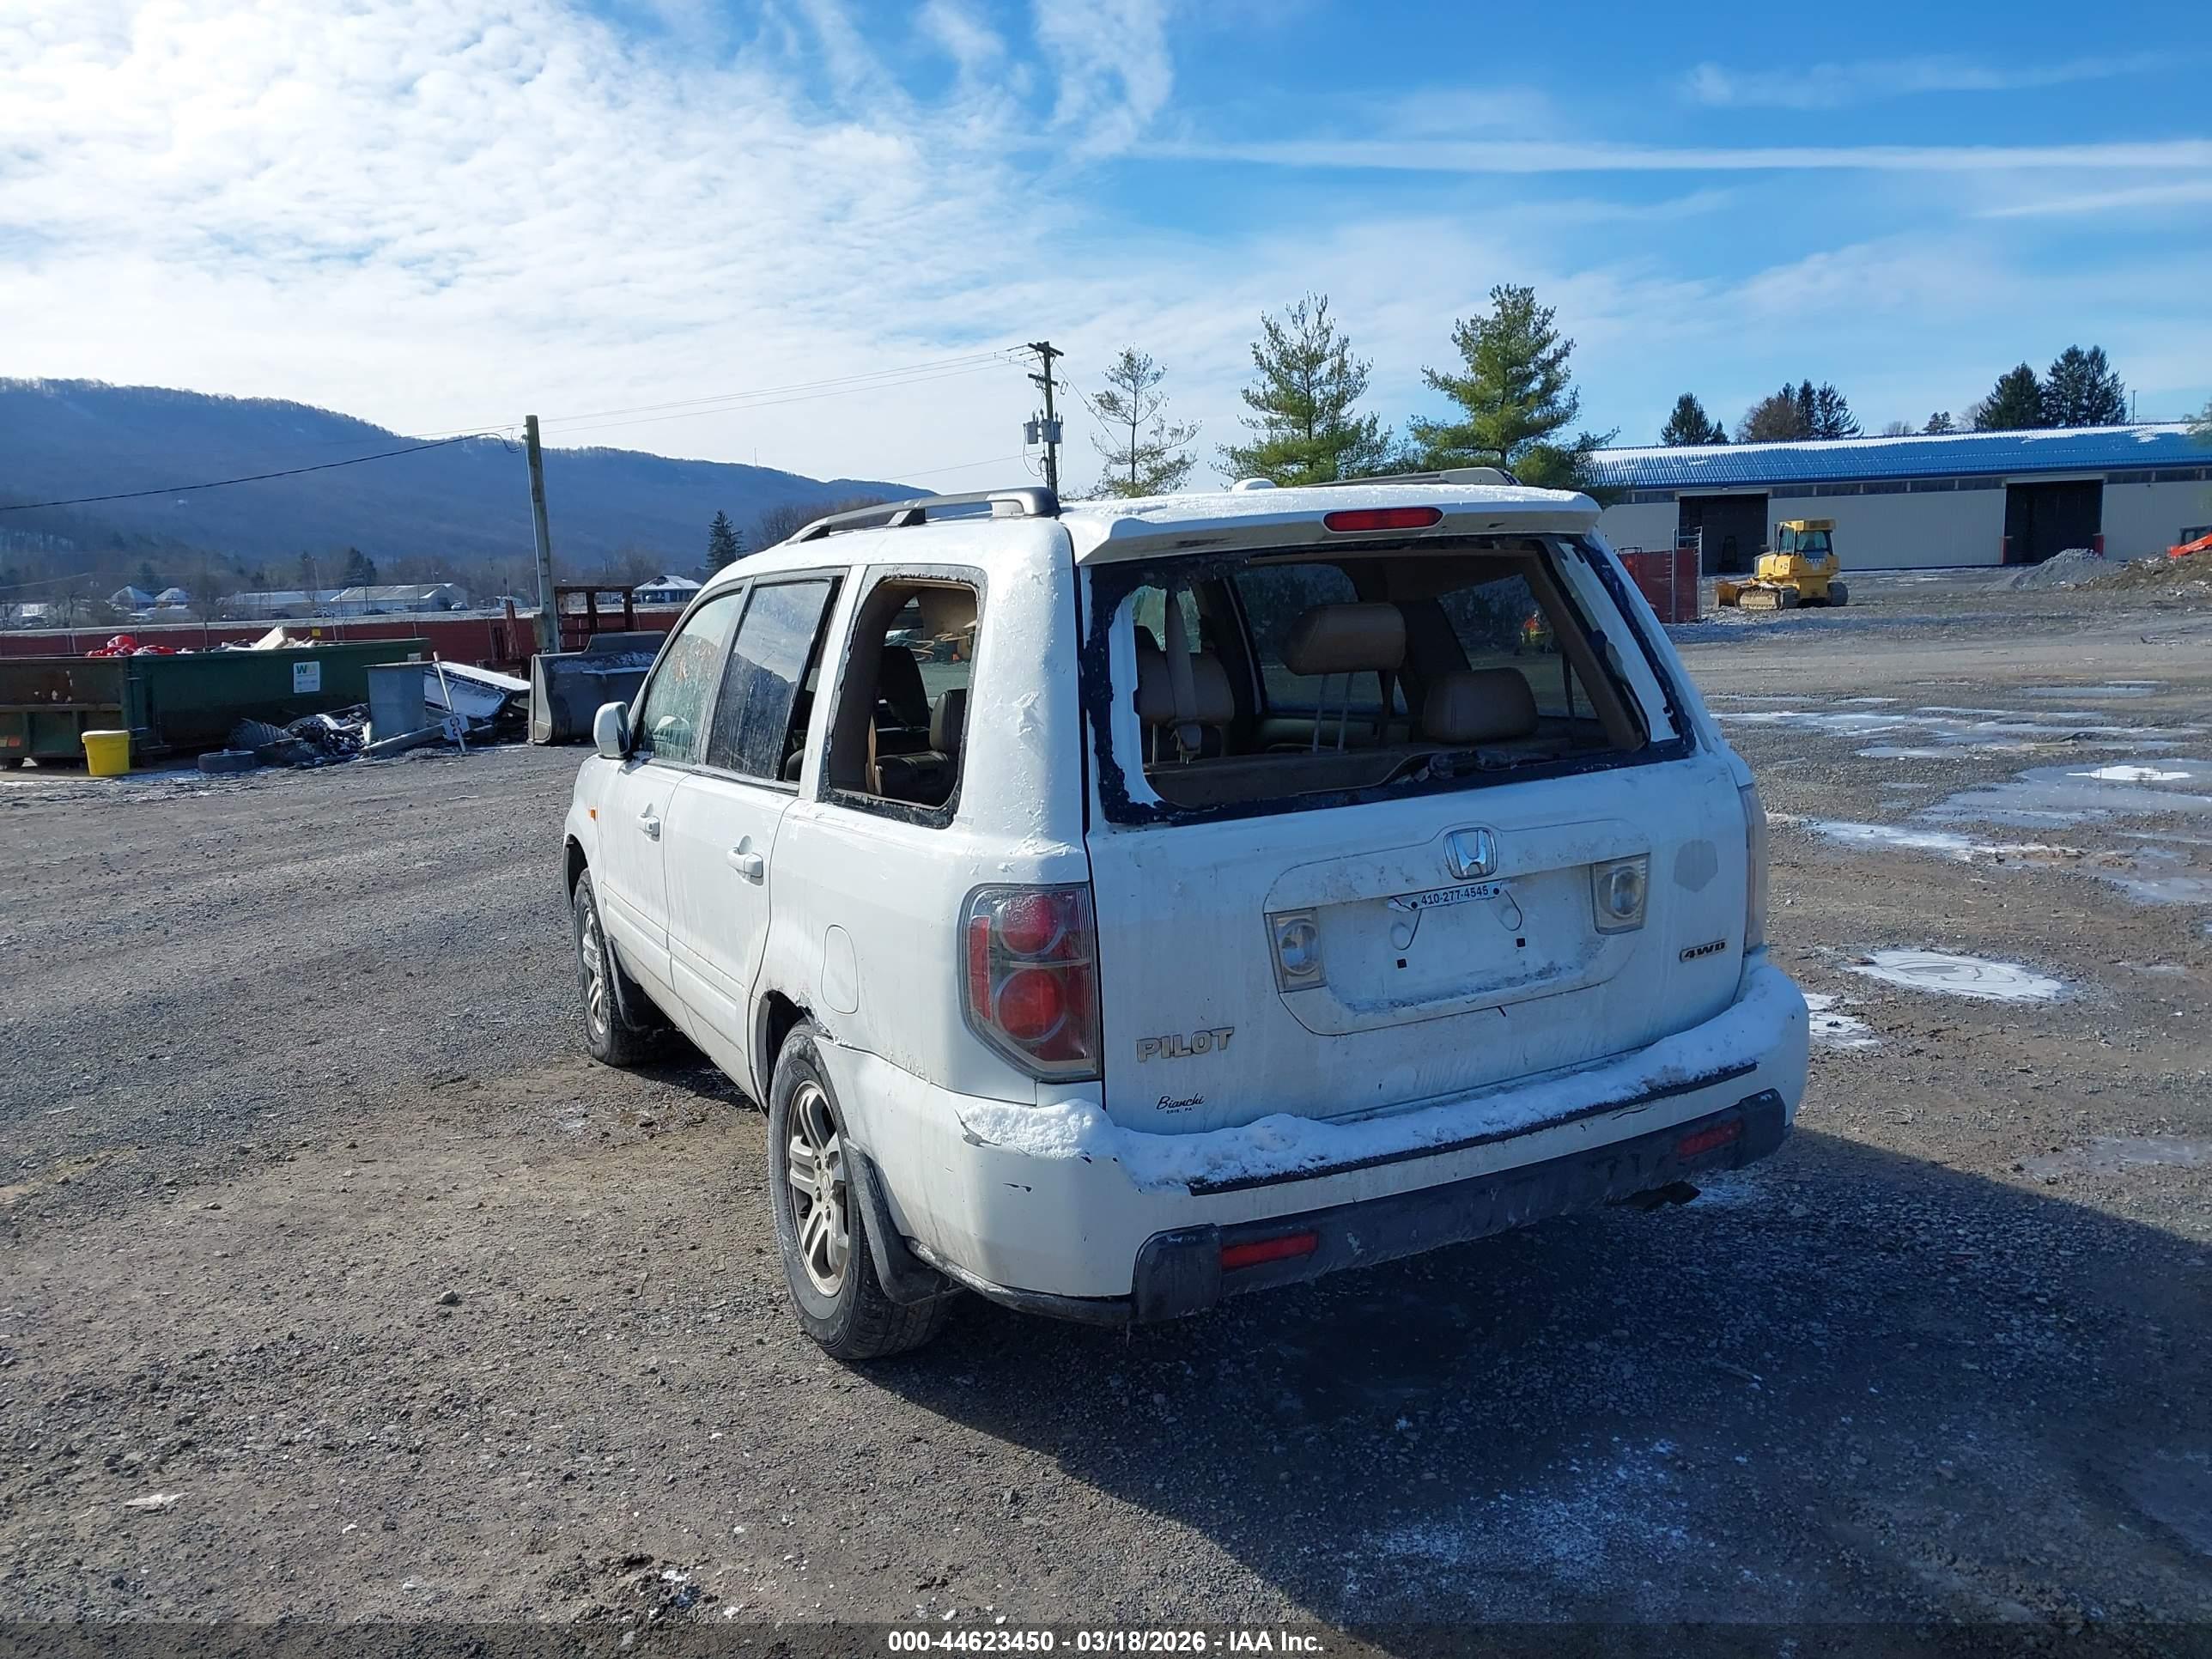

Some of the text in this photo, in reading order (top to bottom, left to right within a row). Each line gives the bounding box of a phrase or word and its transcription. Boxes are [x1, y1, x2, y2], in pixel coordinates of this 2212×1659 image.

[1421, 885, 1489, 906] 410-277-4545
[1136, 1026, 1235, 1063] PILOT
[1156, 1092, 1205, 1110] Bianchi
